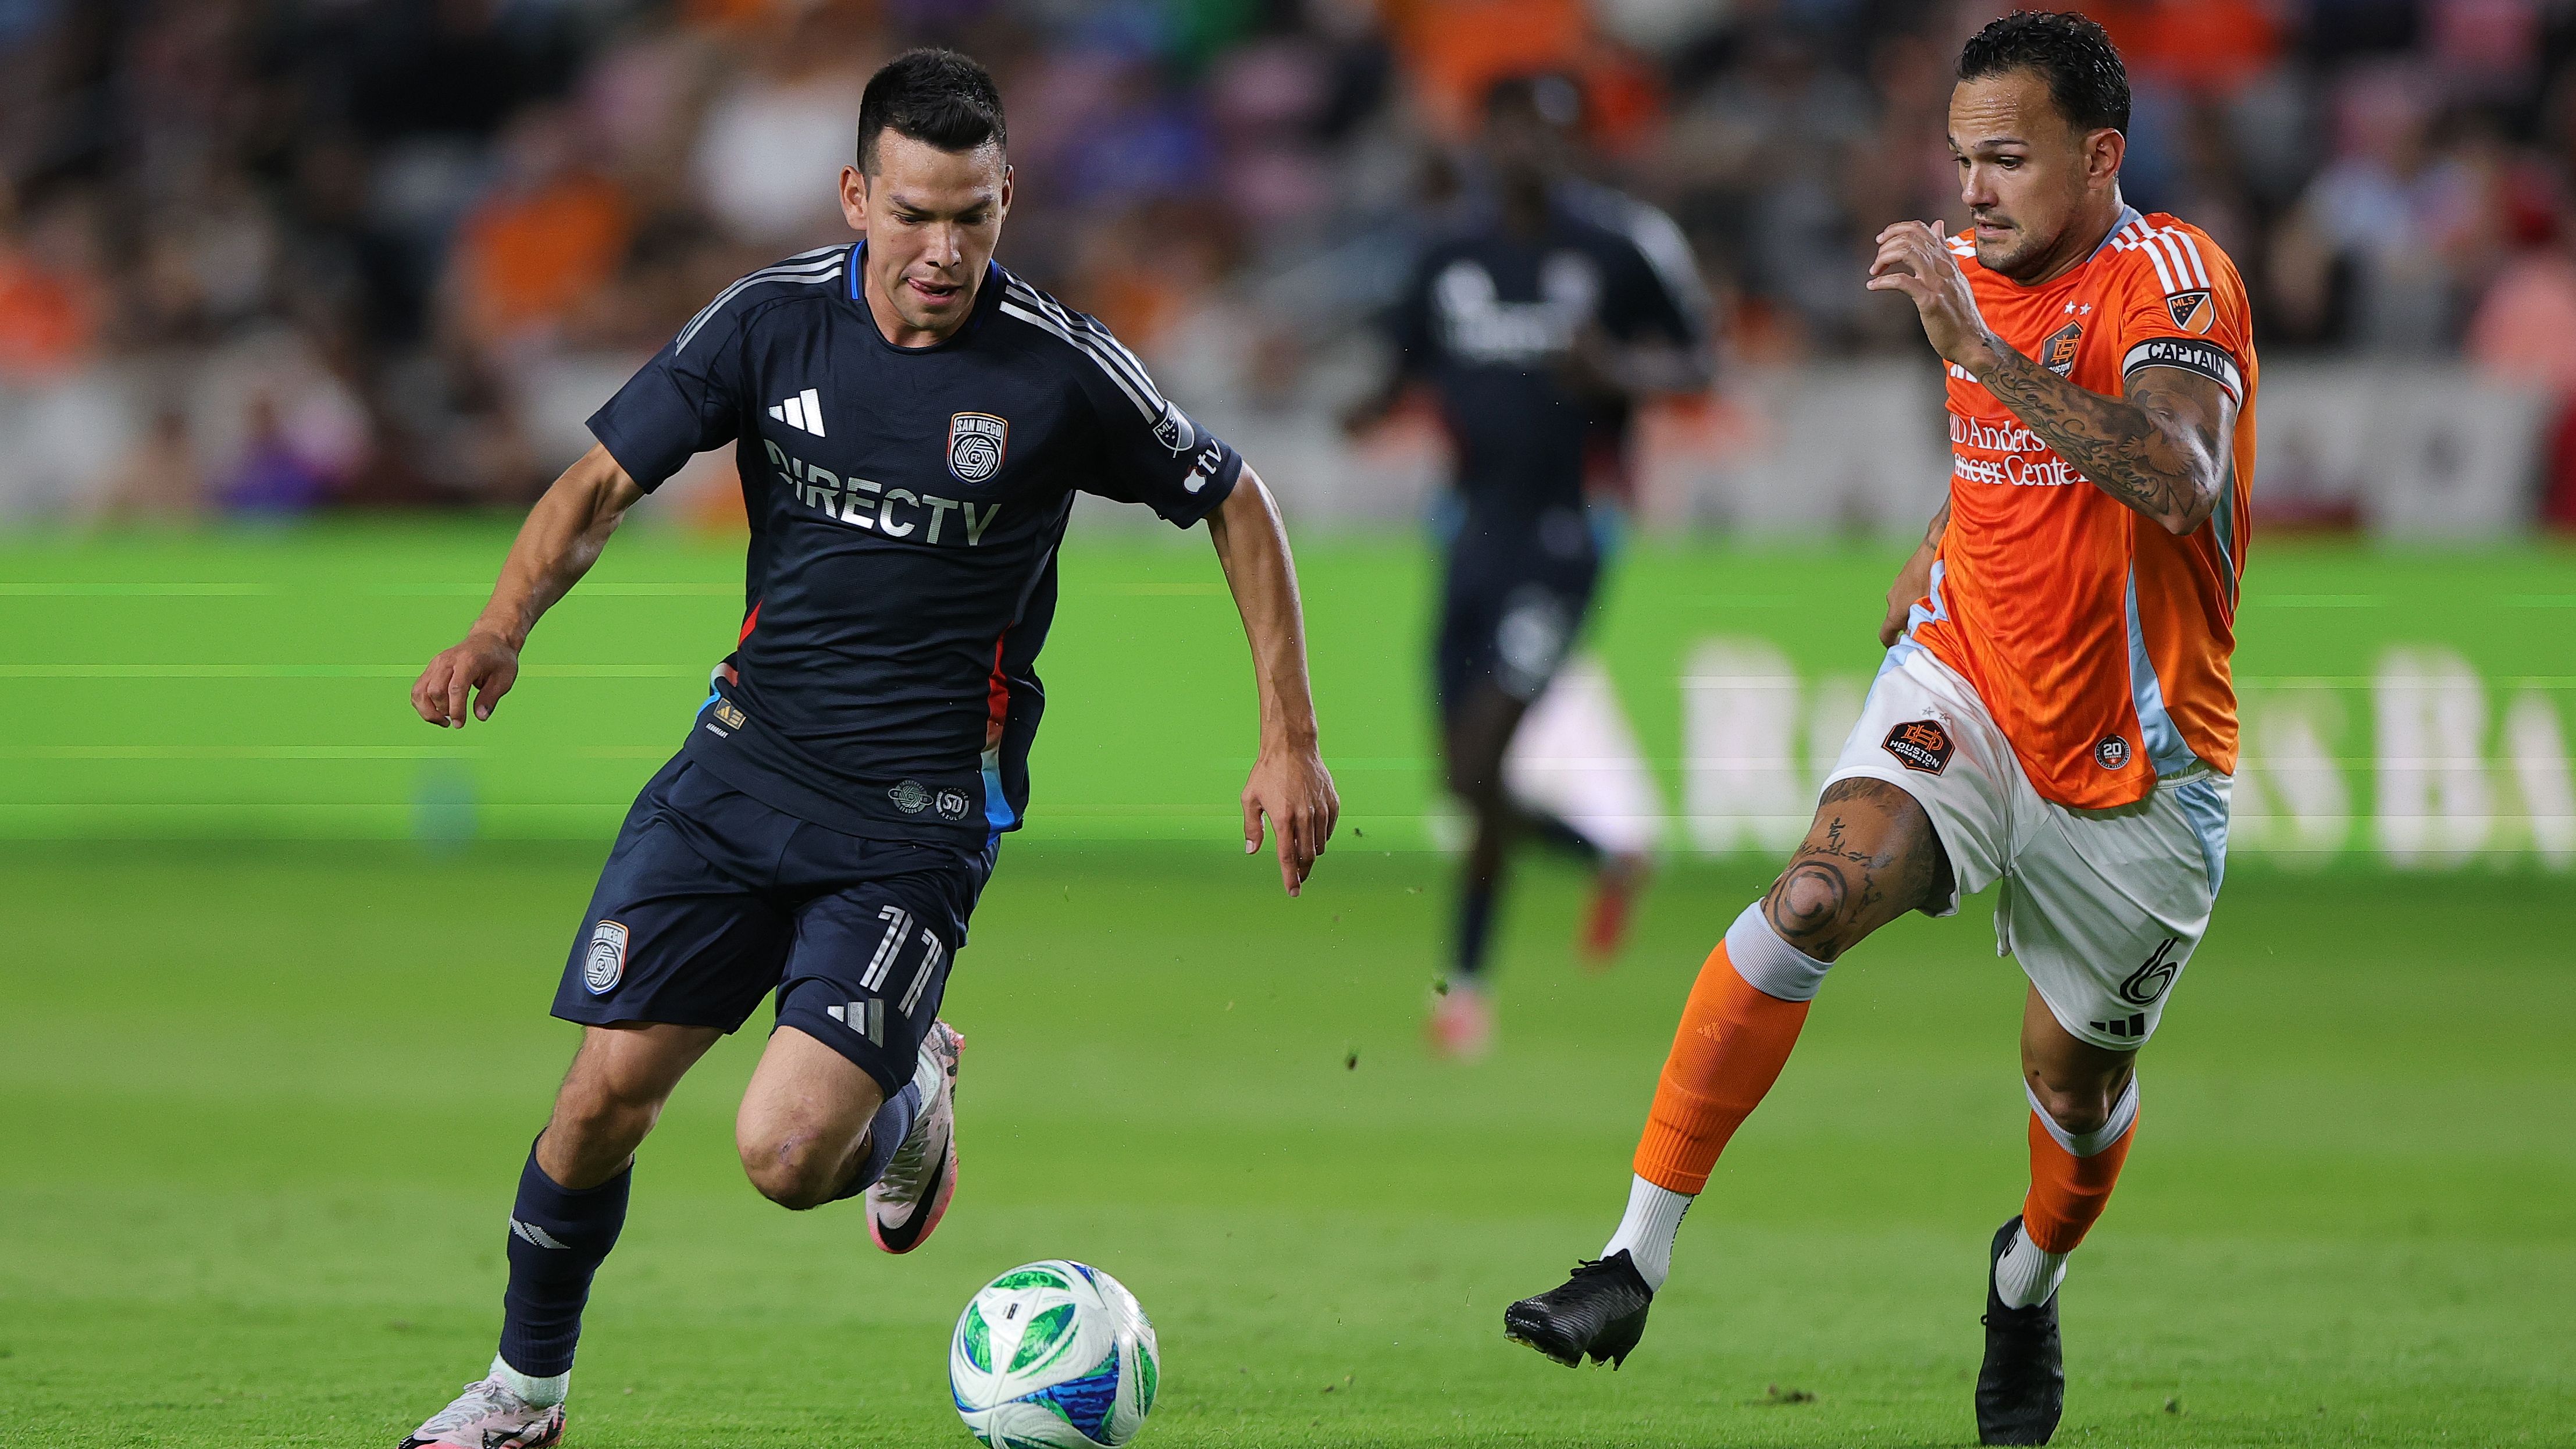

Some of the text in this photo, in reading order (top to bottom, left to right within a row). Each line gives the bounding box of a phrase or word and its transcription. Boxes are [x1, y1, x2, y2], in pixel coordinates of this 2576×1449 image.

[2172, 296, 2196, 309] MLS
[2149, 343, 2225, 377] CAPTAIN
[956, 419, 1002, 437] SAN DIEGO
[1157, 414, 1175, 435] MLS
[1968, 416, 2052, 453] Anders
[970, 453, 981, 462] FC
[1198, 439, 1222, 475] tv
[764, 439, 1002, 546] DIRECTV
[1890, 740, 1940, 768] HOUSTON
[1895, 748, 1922, 761] DYNAMO
[2103, 742, 2122, 756] 20
[943, 793, 963, 813] SD
[860, 905, 942, 1020] 11
[2119, 937, 2179, 1007] 6
